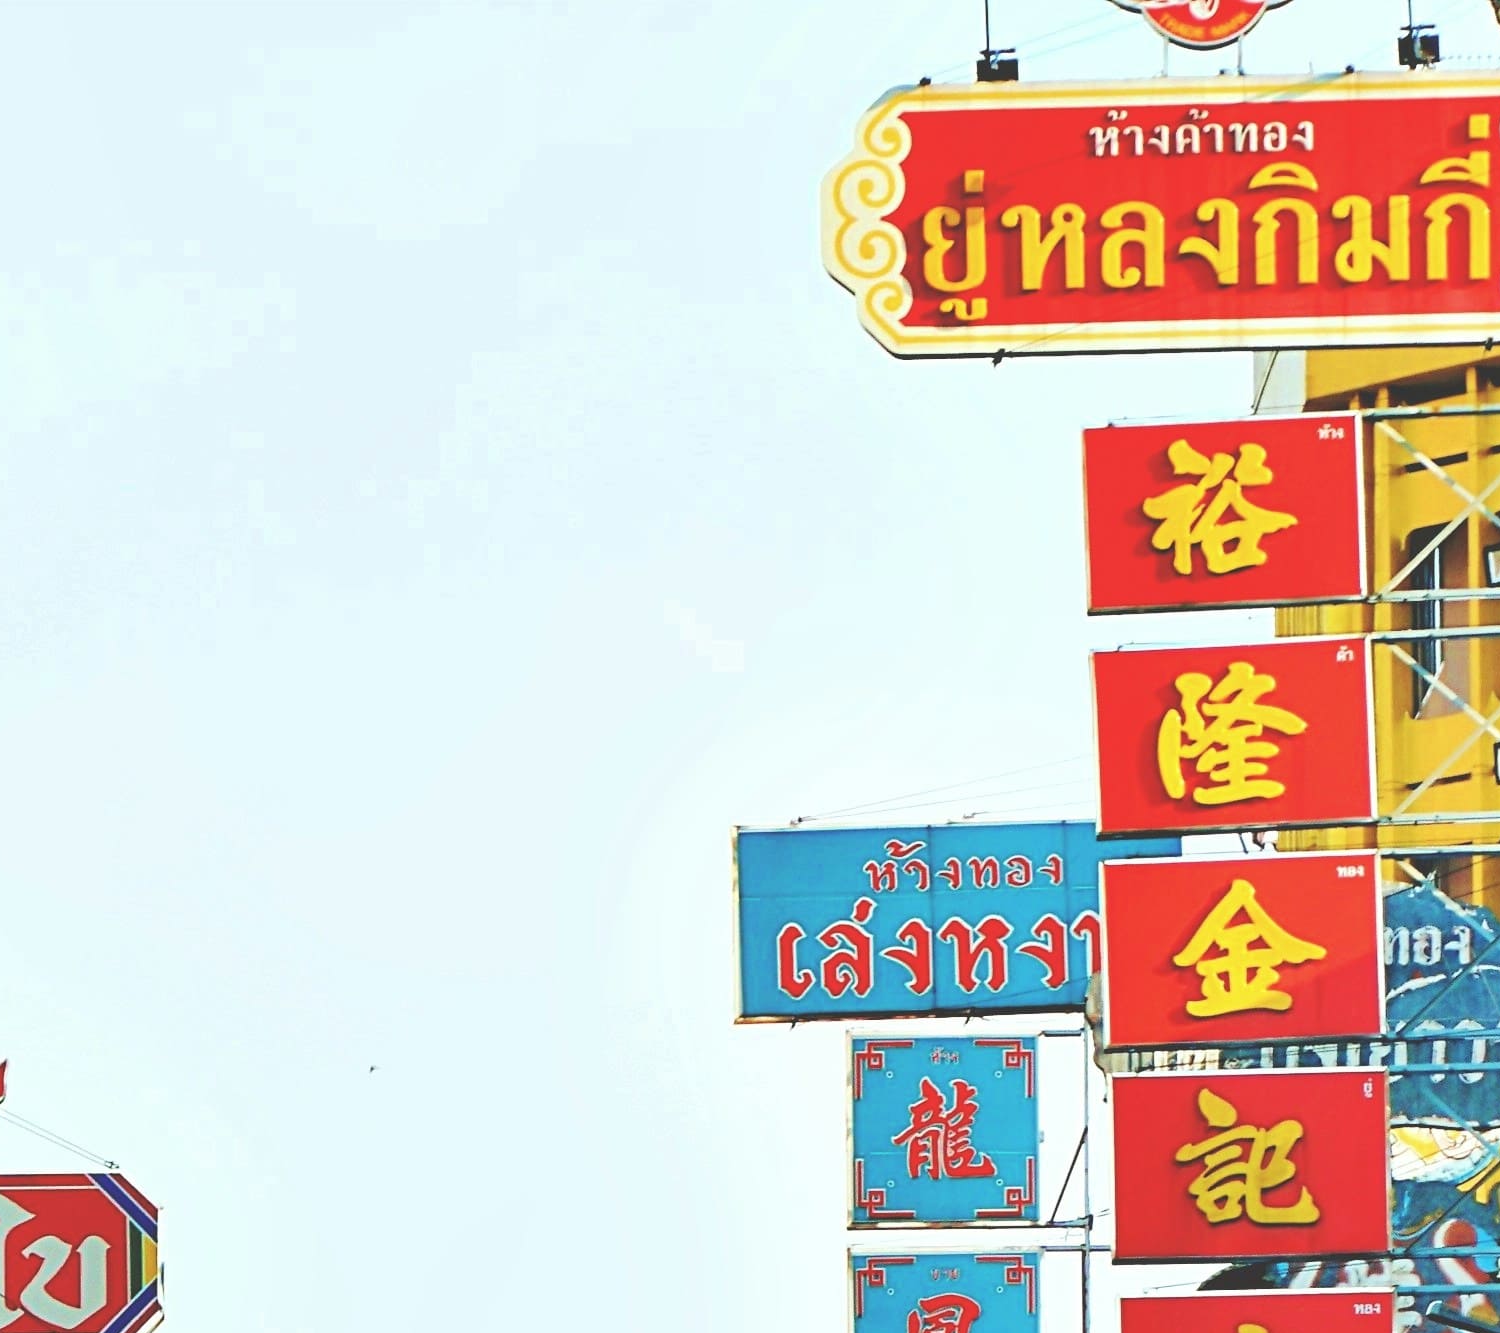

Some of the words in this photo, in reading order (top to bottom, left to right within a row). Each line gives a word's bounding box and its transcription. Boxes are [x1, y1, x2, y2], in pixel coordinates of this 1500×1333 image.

[1088, 108, 1317, 158] ห้างค้าทอง
[864, 837, 1065, 891] ห้างทอง
[776, 896, 1100, 1000] เล่งหง
